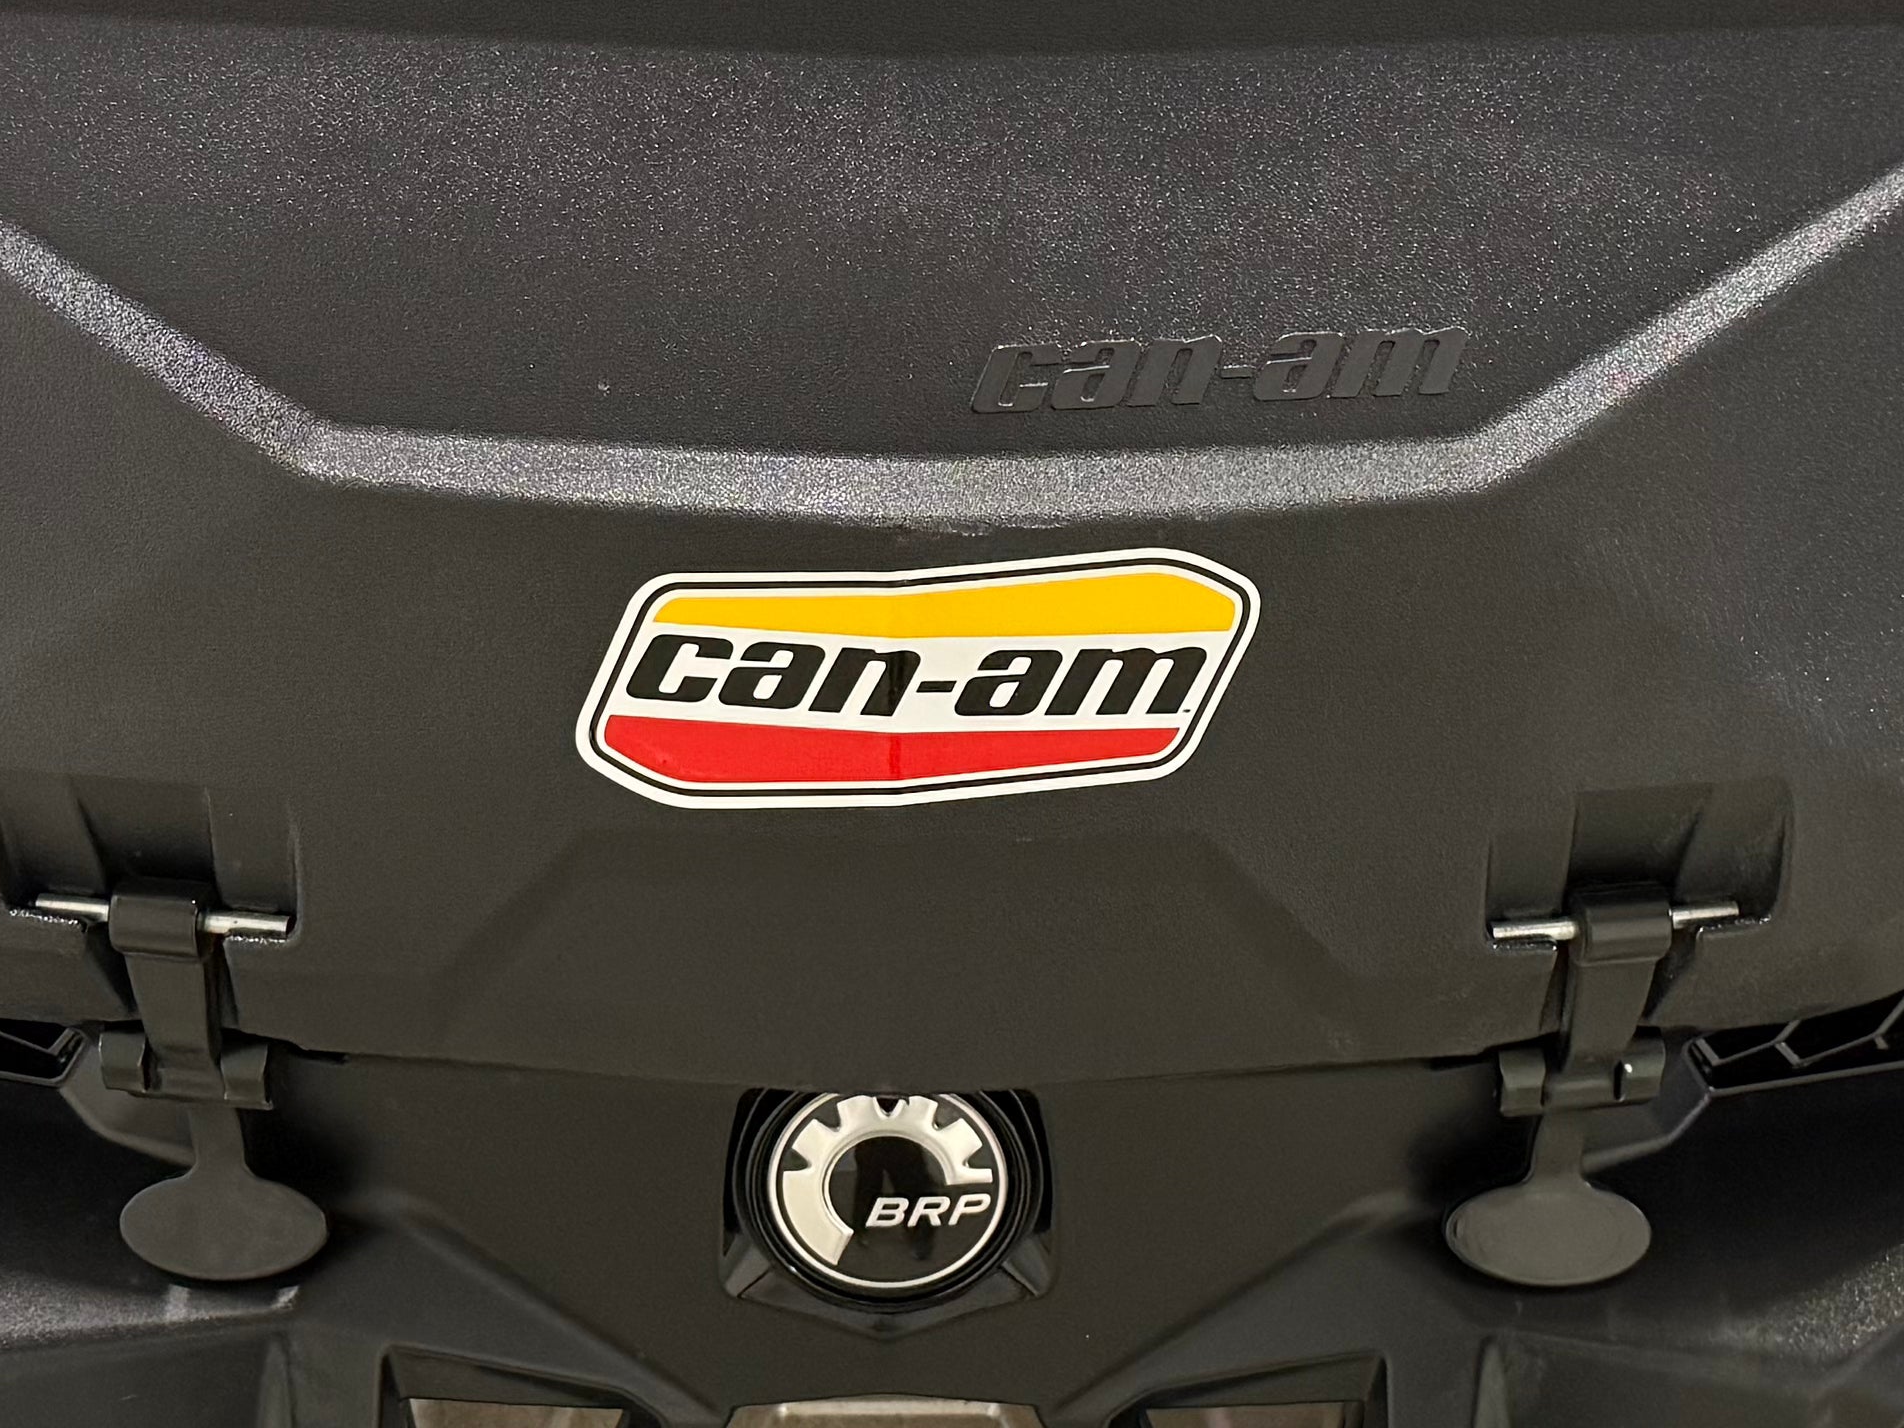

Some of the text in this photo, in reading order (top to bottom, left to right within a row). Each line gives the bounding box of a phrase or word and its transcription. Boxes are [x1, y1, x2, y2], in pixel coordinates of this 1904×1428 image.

[970, 326, 1472, 413] can-am
[626, 634, 1208, 718] can-am
[864, 1191, 994, 1229] BRP
